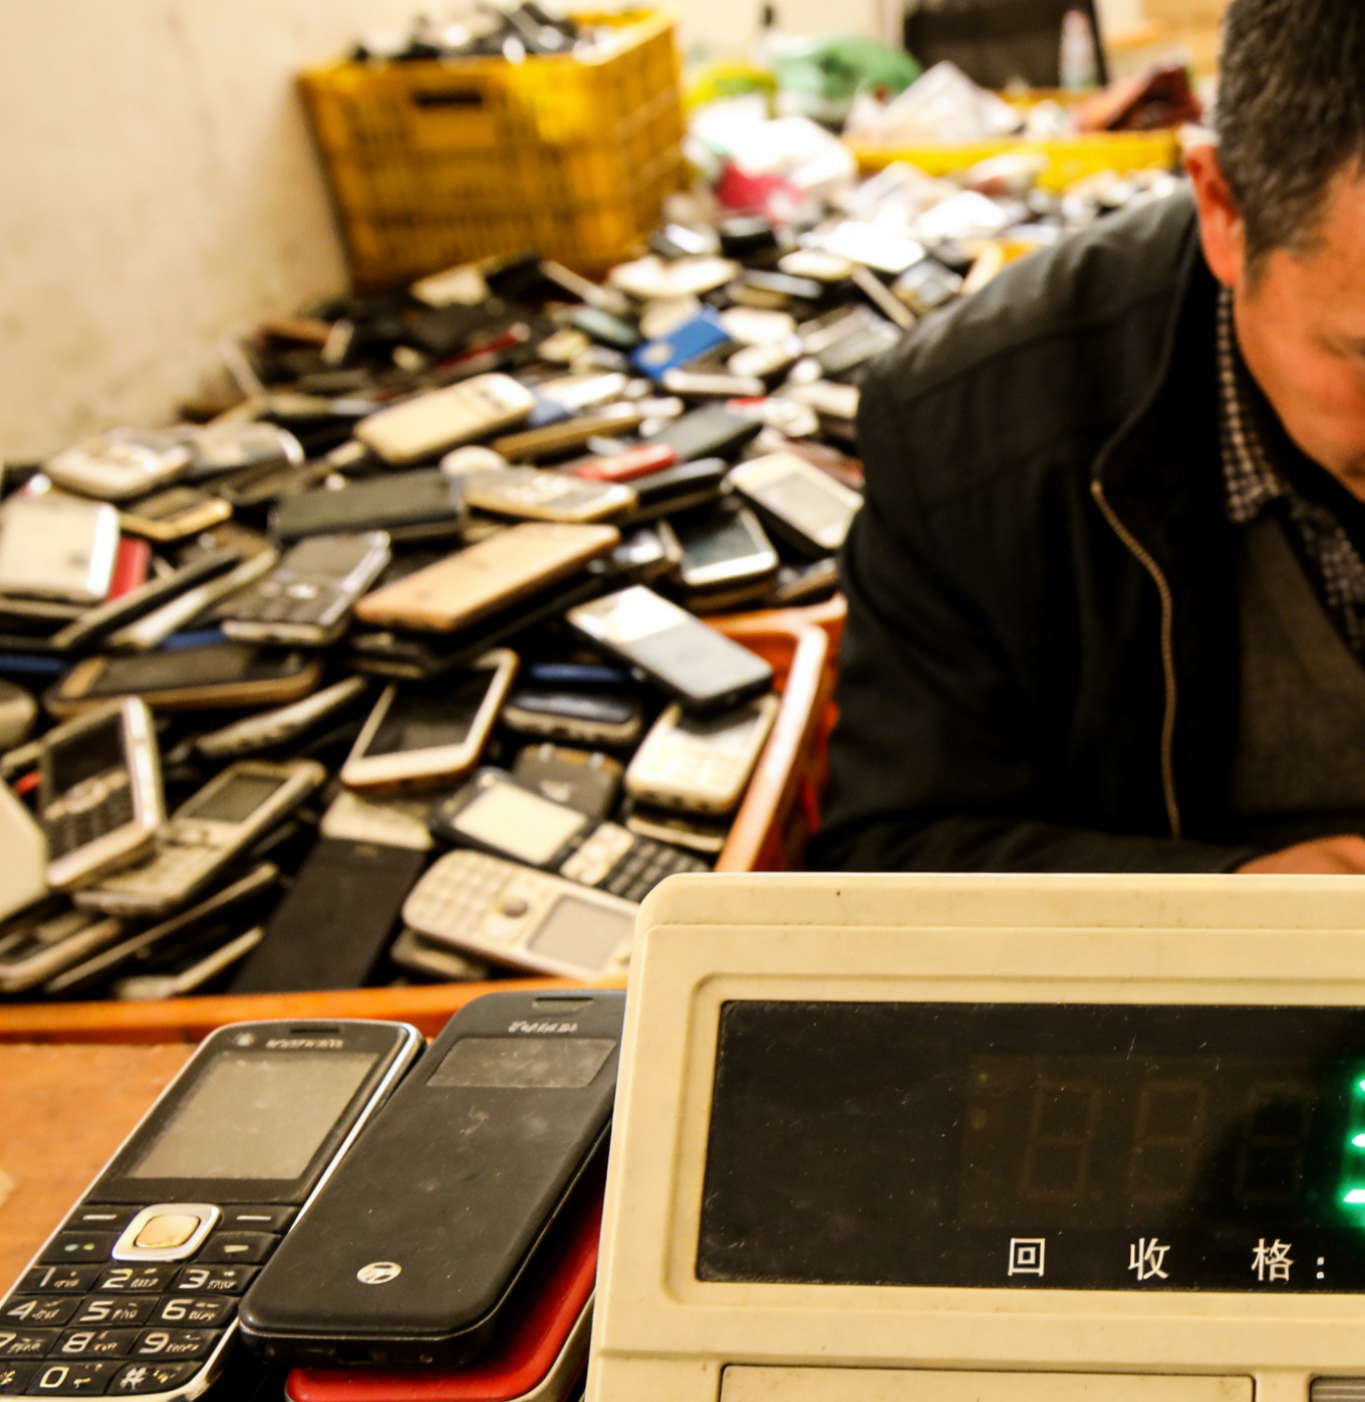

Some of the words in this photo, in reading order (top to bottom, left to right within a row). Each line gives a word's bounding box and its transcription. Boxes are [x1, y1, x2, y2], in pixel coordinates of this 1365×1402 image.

[39, 1266, 57, 1288] 1
[101, 1268, 135, 1289] 2
[178, 1269, 210, 1289] 3
[6, 1299, 38, 1321] 4
[79, 1300, 114, 1321] 5
[161, 1299, 194, 1321] 6
[61, 1331, 96, 1354] 8
[138, 1332, 170, 1354] 9
[39, 1366, 70, 1389] 0
